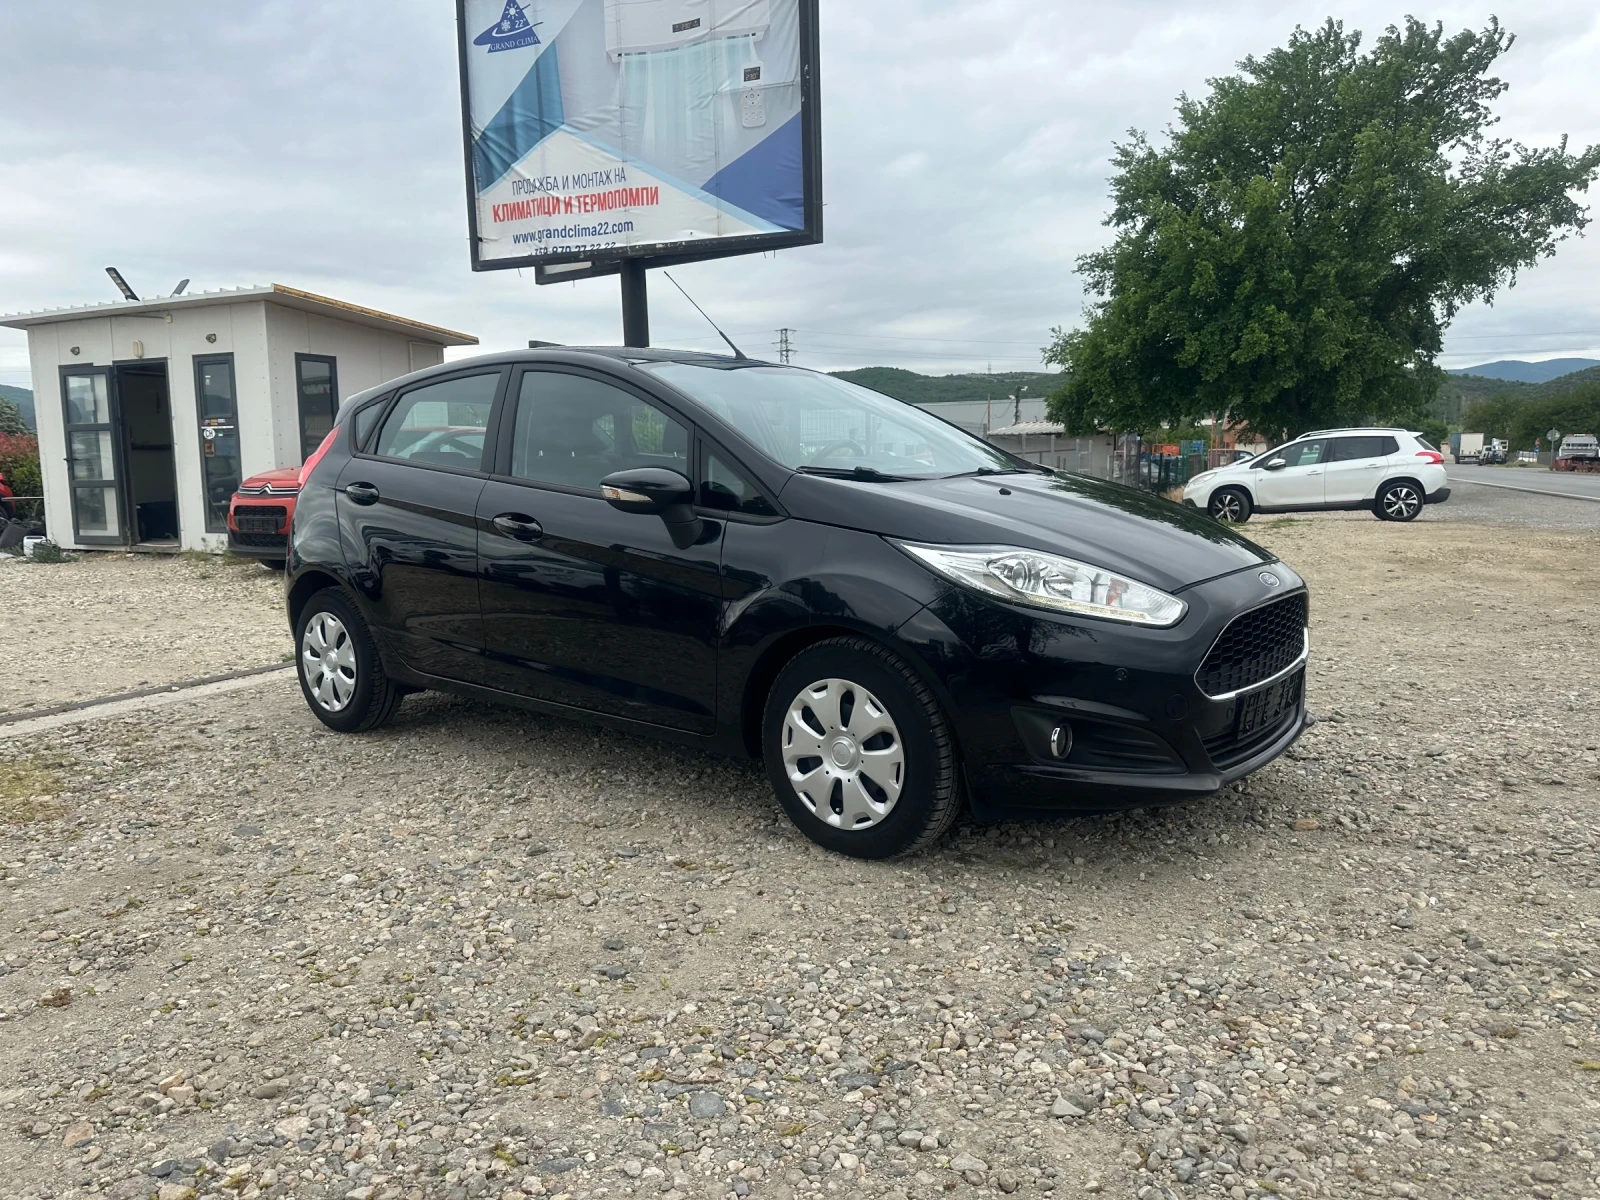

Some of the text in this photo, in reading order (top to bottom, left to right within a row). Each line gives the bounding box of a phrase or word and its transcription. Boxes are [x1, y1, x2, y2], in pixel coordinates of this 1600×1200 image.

[490, 36, 538, 51] GRAND CLIMA
[512, 167, 627, 196] ПРОДАЖБА И МОНТАЖ НА
[492, 186, 659, 223] КЛИМАТИЦИ И ТЕРМОПОМПИ
[513, 220, 634, 244] www.grandclima22.com
